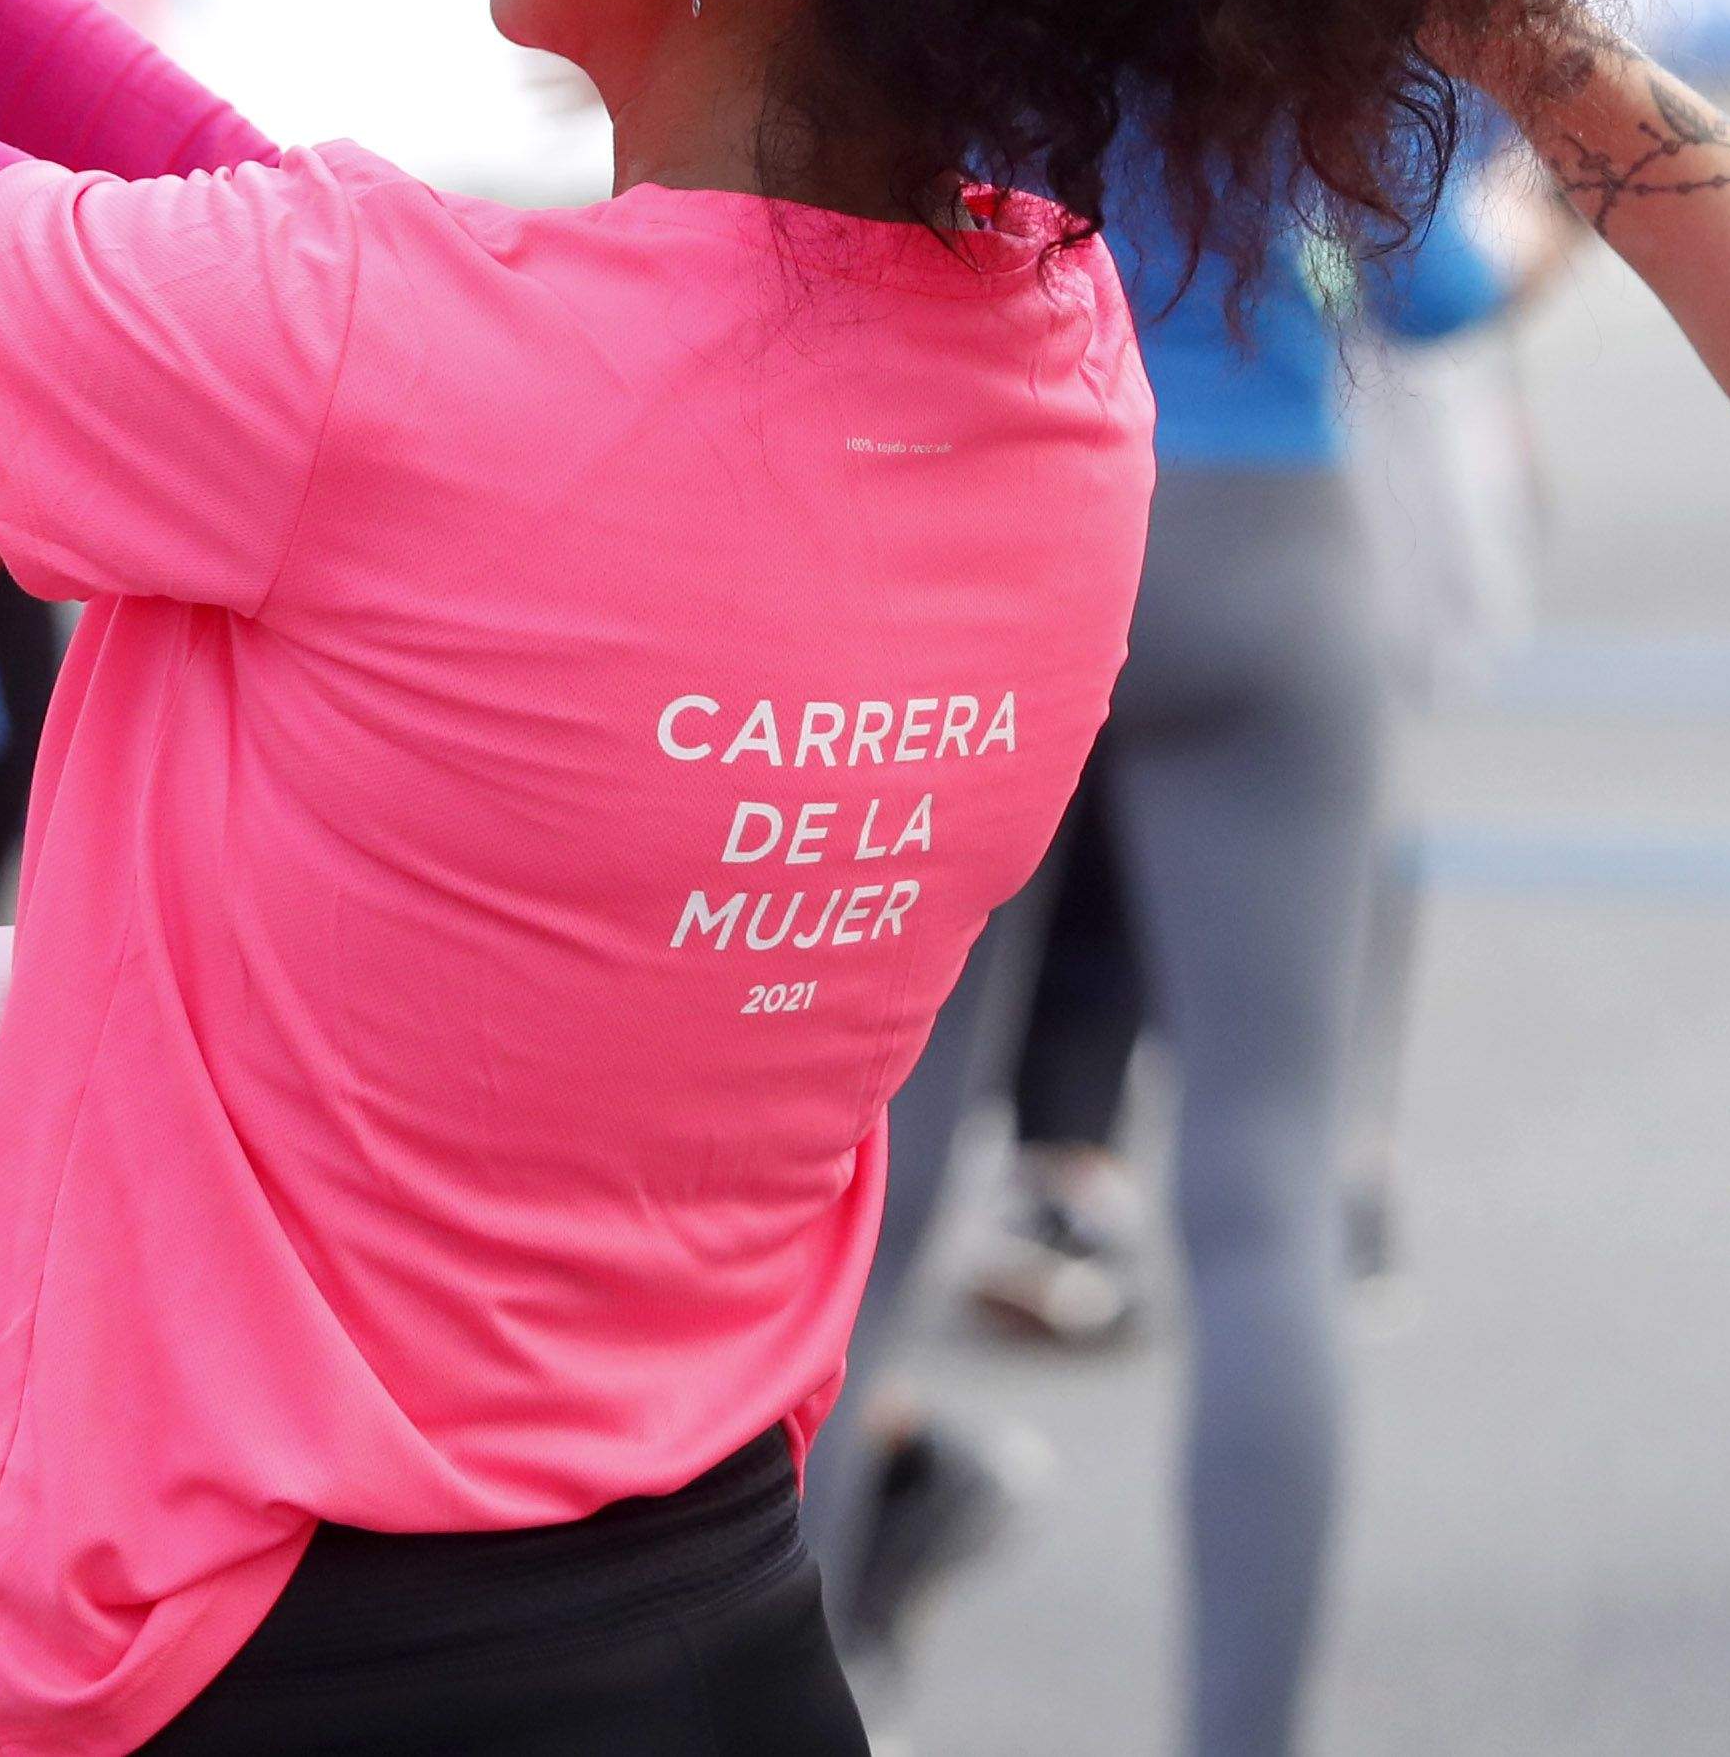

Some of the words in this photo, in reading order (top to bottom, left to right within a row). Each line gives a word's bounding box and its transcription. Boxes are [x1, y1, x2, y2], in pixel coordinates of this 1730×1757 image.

[657, 691, 1016, 768] CARRERA
[721, 801, 838, 865] DE
[855, 793, 933, 862] LA
[670, 879, 921, 951] MUJER
[740, 981, 817, 1014] 2021
